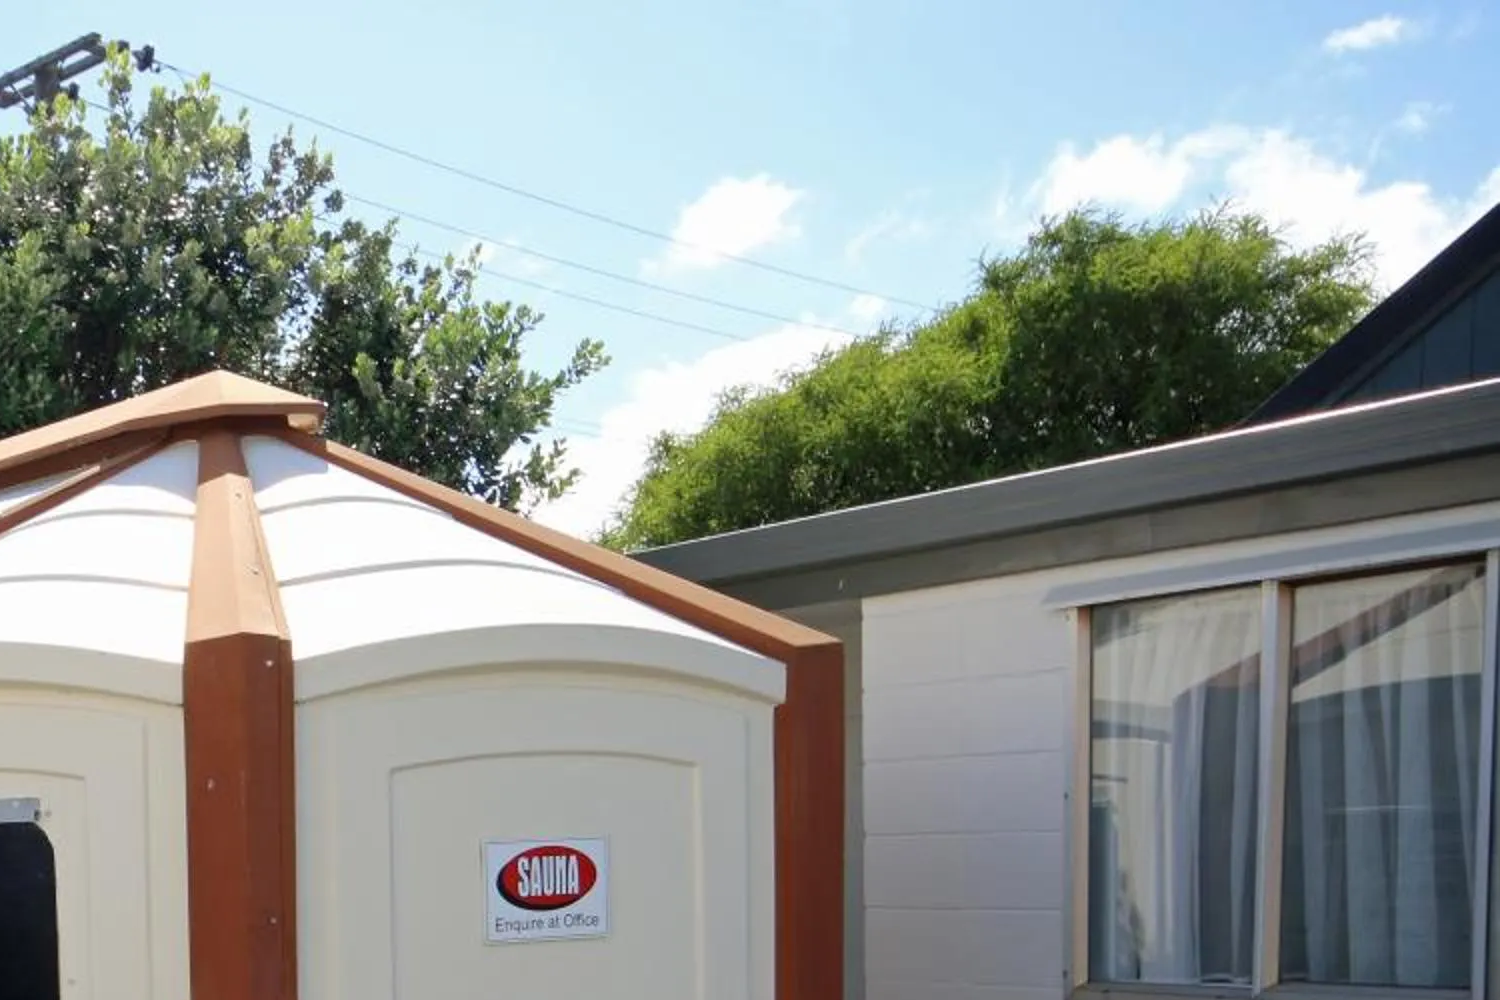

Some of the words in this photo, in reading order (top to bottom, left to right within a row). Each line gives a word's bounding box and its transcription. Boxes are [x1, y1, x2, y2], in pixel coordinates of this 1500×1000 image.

[517, 855, 580, 897] SAUNA
[548, 914, 560, 929] at
[563, 912, 599, 928] Office
